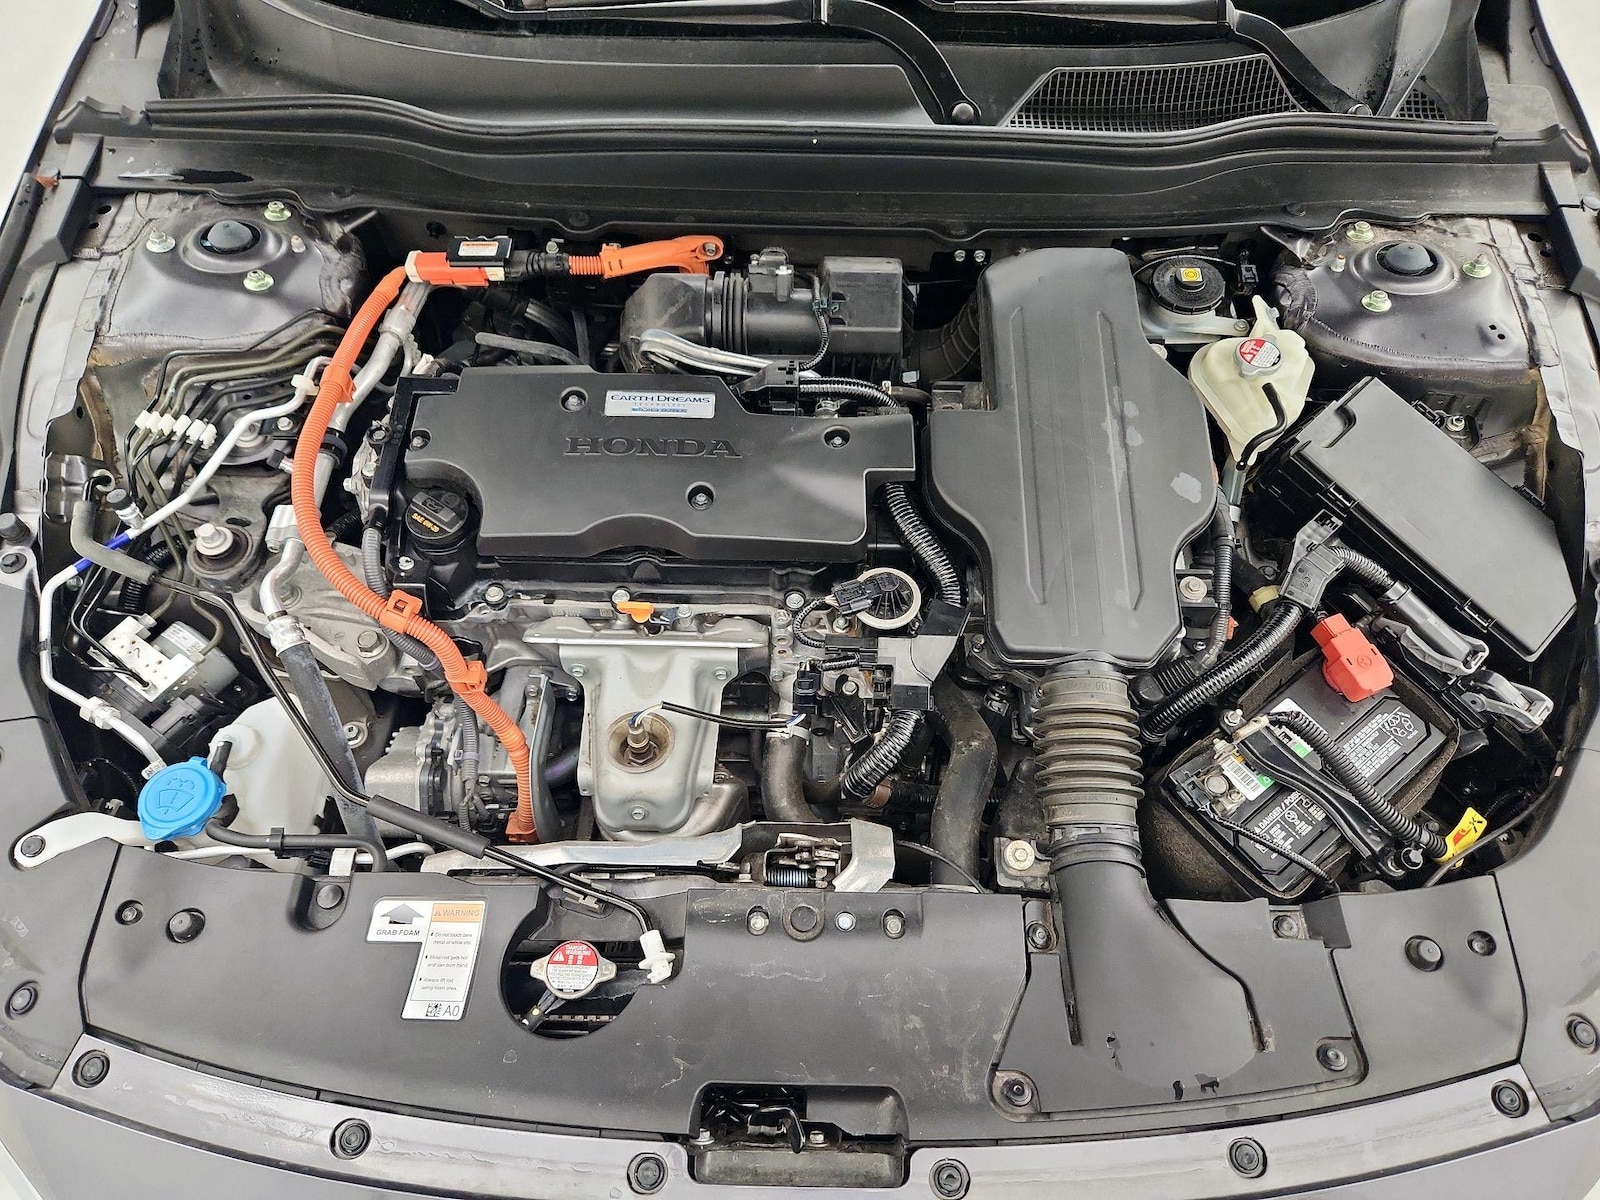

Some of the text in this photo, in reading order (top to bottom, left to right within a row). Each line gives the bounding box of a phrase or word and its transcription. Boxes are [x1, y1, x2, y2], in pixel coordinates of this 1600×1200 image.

[657, 394, 710, 403] DREAMS
[562, 436, 742, 458] HONDA
[1258, 806, 1284, 830] DANGER
[442, 909, 480, 917] WARNING
